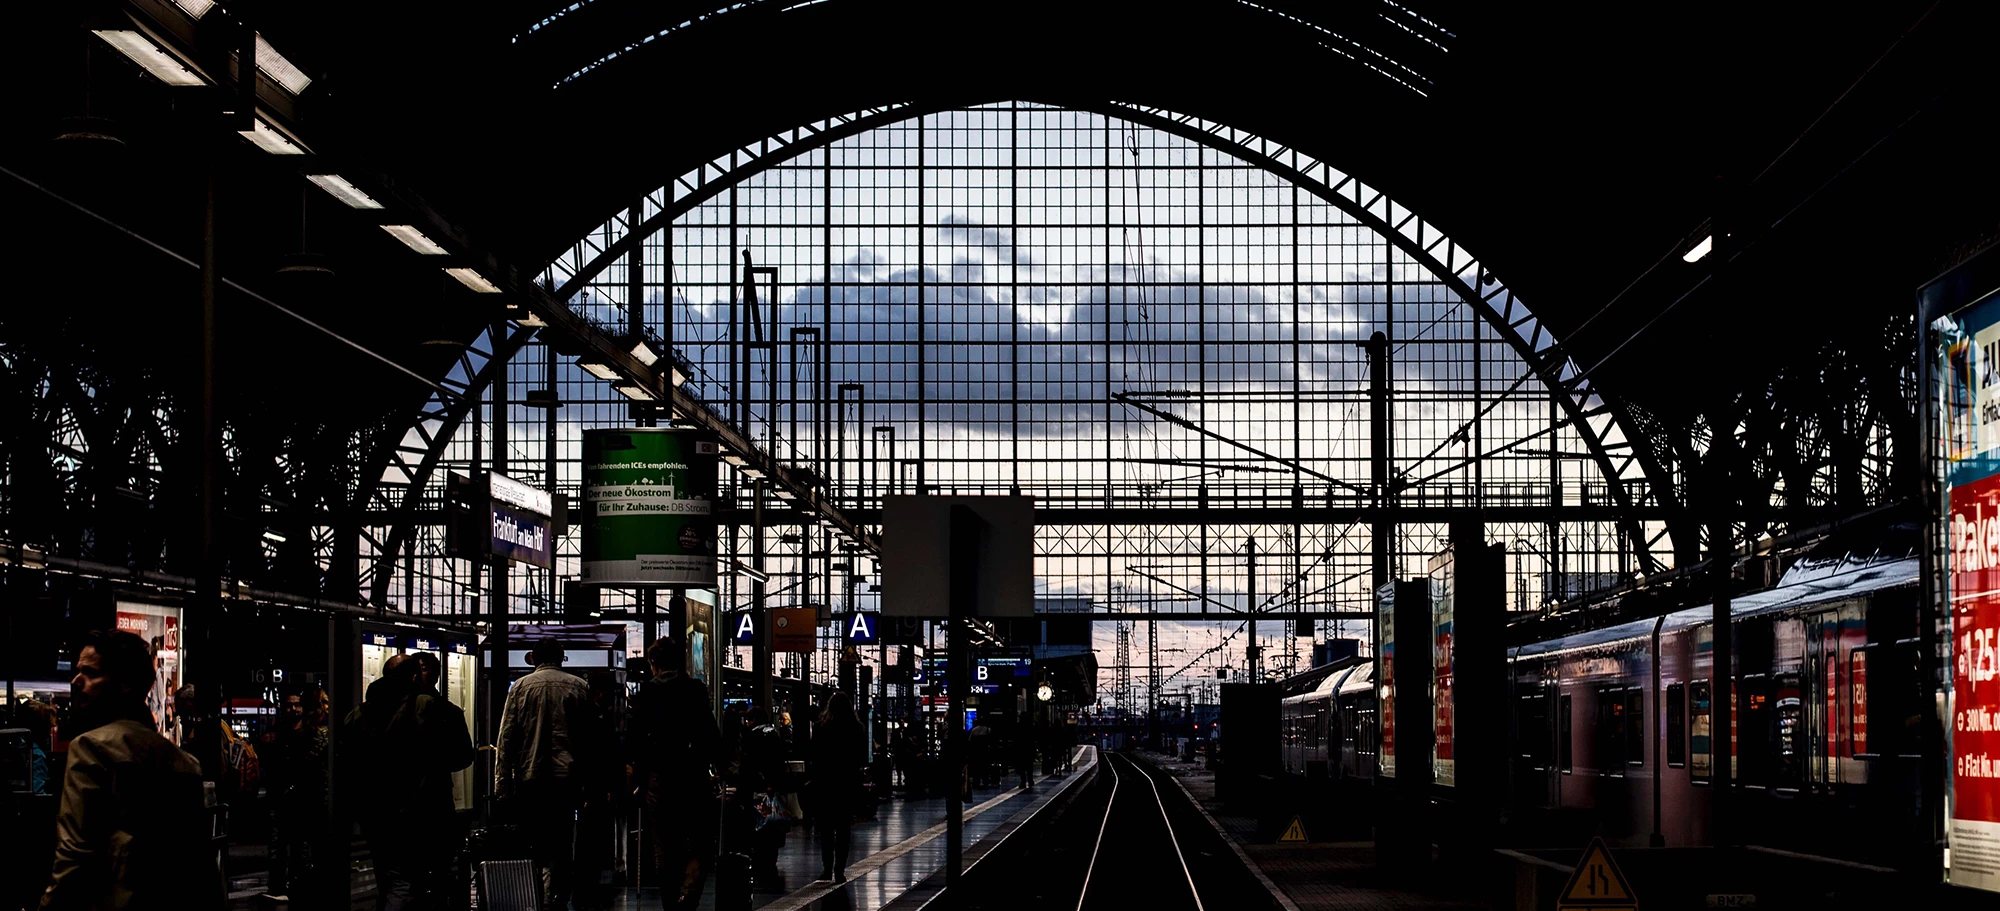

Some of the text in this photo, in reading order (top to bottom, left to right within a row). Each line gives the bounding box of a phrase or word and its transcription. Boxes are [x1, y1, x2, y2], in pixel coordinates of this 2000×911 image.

[598, 462, 630, 470] fahrenden
[647, 462, 688, 471] empfohlen.
[588, 490, 601, 498] Der
[625, 487, 671, 497] Ökostrom
[599, 503, 710, 513] für Ihr Zuhause: DB Strom.
[493, 511, 518, 545] Frankfurt
[533, 525, 544, 552] Hbf
[117, 617, 149, 631] JEDER MORNING
[736, 613, 754, 638] A
[850, 613, 871, 638] A
[1965, 627, 1995, 693] 1,25
[249, 668, 265, 683] 16
[272, 668, 284, 683] B
[977, 666, 989, 681] B
[1966, 708, 1979, 732] 300
[1965, 752, 1981, 777] Flat
